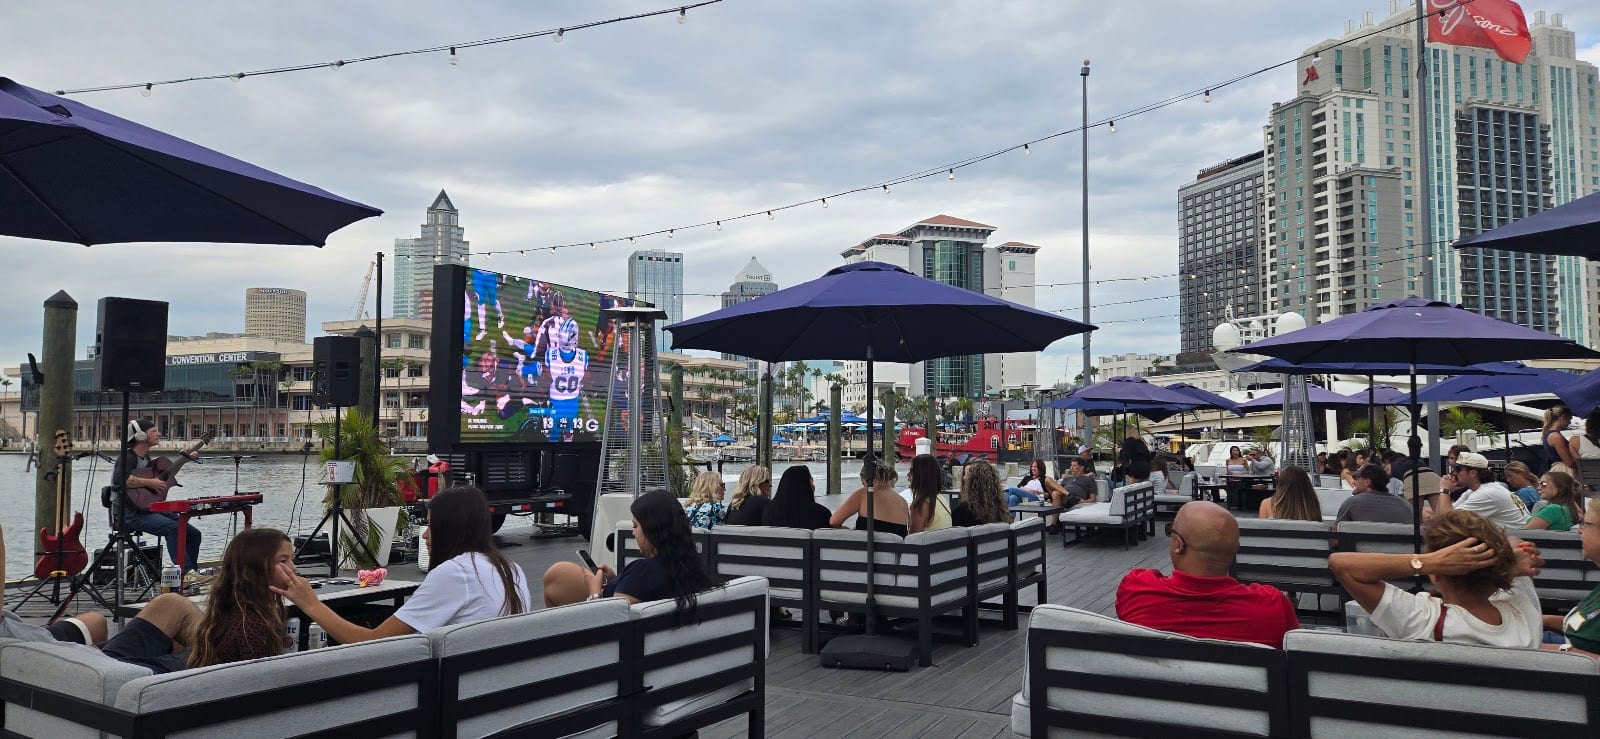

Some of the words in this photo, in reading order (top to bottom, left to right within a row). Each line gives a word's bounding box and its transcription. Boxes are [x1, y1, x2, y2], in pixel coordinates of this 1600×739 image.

[172, 354, 215, 365] CONVENTION
[218, 352, 247, 362] CENTER
[542, 417, 554, 429] 13
[572, 417, 583, 429] 13
